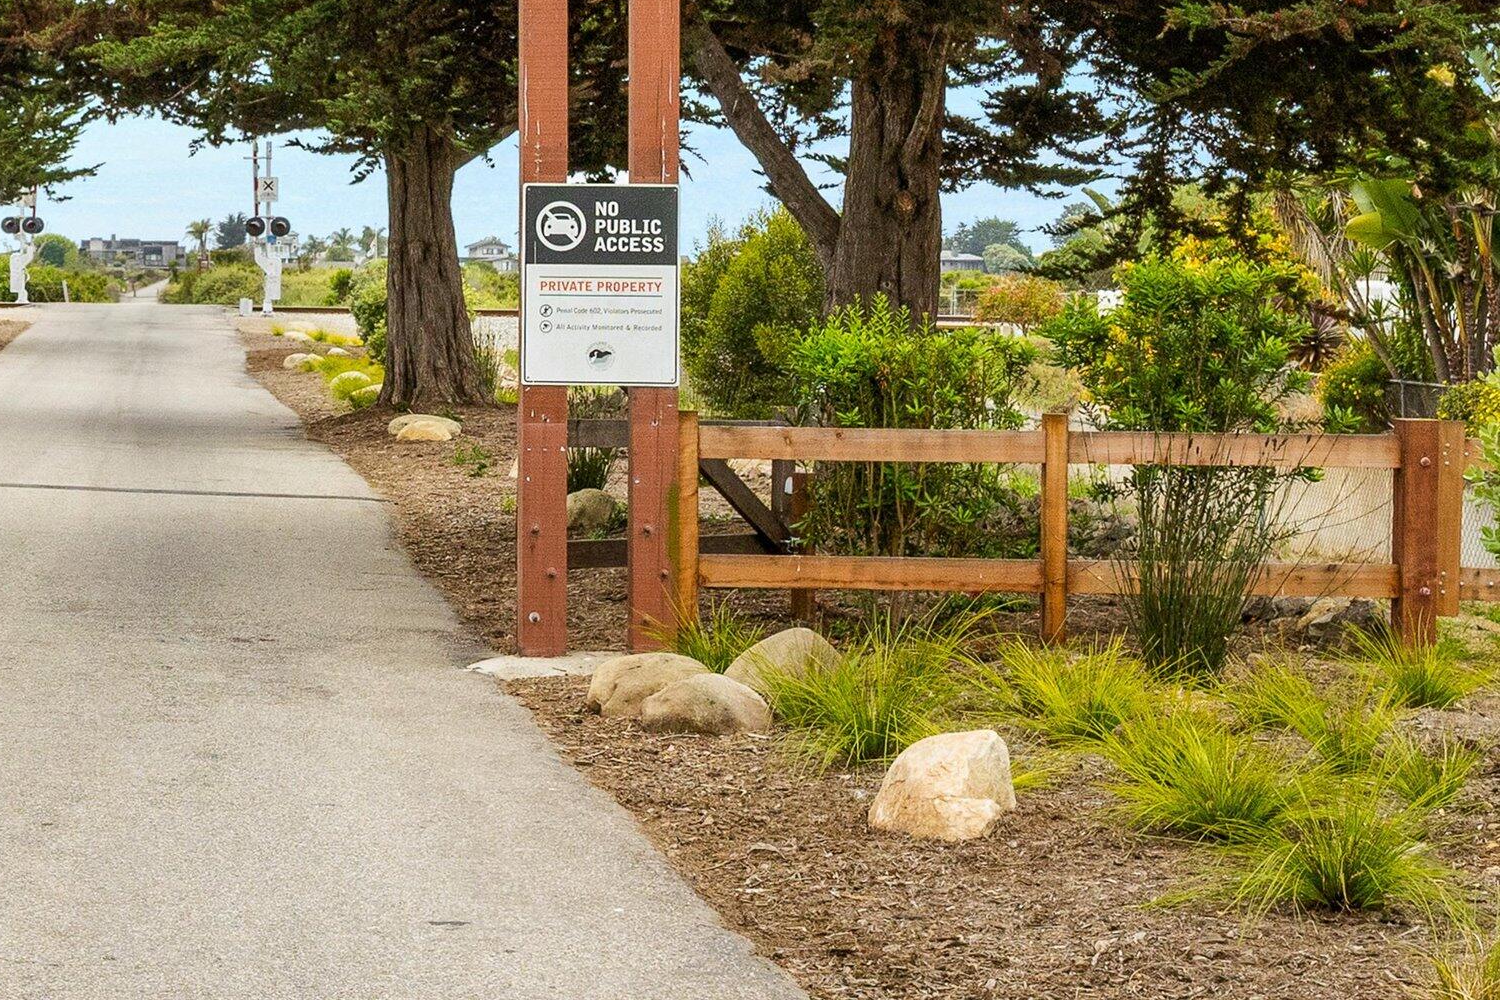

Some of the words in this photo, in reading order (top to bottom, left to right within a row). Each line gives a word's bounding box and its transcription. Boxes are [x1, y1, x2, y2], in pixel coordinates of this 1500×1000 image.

[594, 201, 620, 217] NO
[594, 219, 662, 235] PUBLIC
[594, 236, 665, 252] ACCESS
[540, 280, 593, 292] PRIVATE
[596, 281, 662, 293] PROPERTY
[573, 307, 588, 315] Code
[630, 307, 662, 315] Prosecuted
[566, 323, 590, 331] Activity
[592, 323, 623, 331] Monitored
